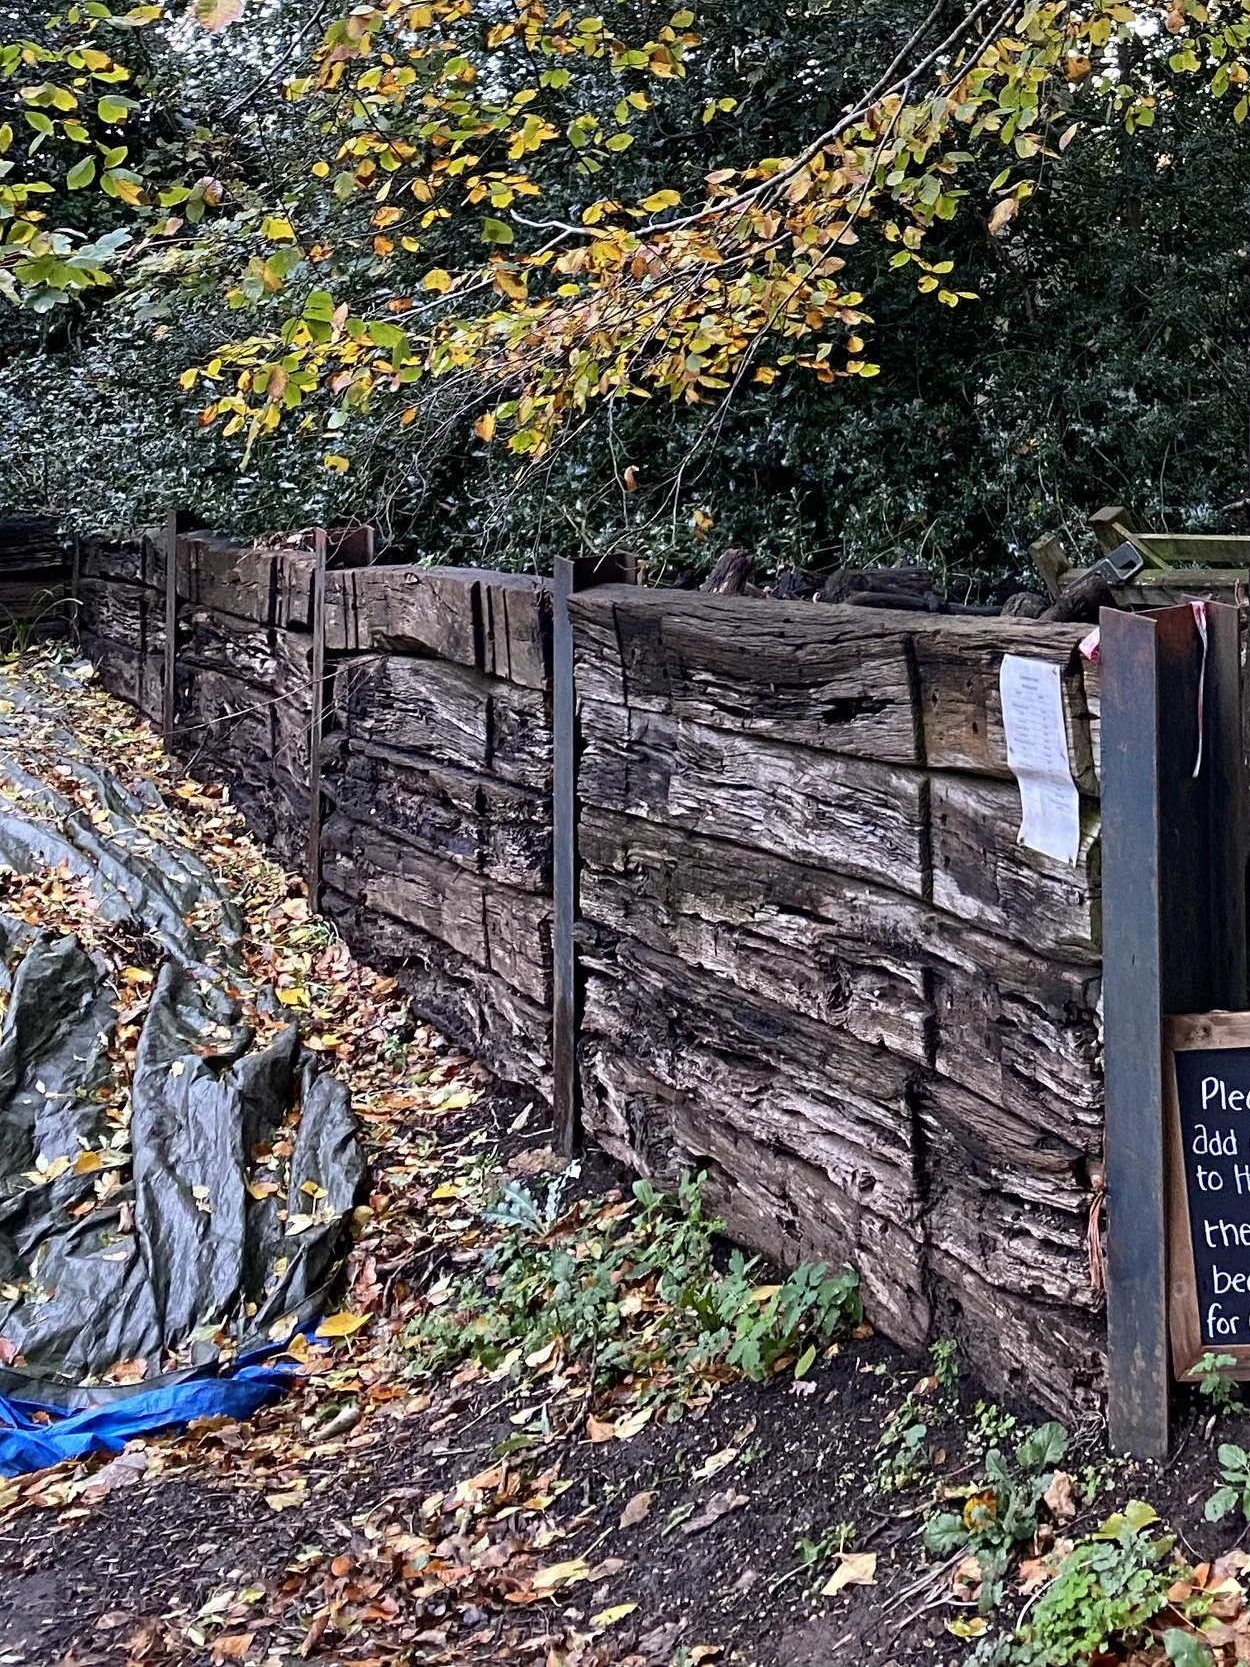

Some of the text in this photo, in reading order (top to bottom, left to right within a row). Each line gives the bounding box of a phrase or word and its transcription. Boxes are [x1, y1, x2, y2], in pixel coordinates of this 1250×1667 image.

[1193, 1124, 1237, 1156] add
[1197, 1165, 1223, 1190] to
[1207, 1303, 1239, 1338] for
